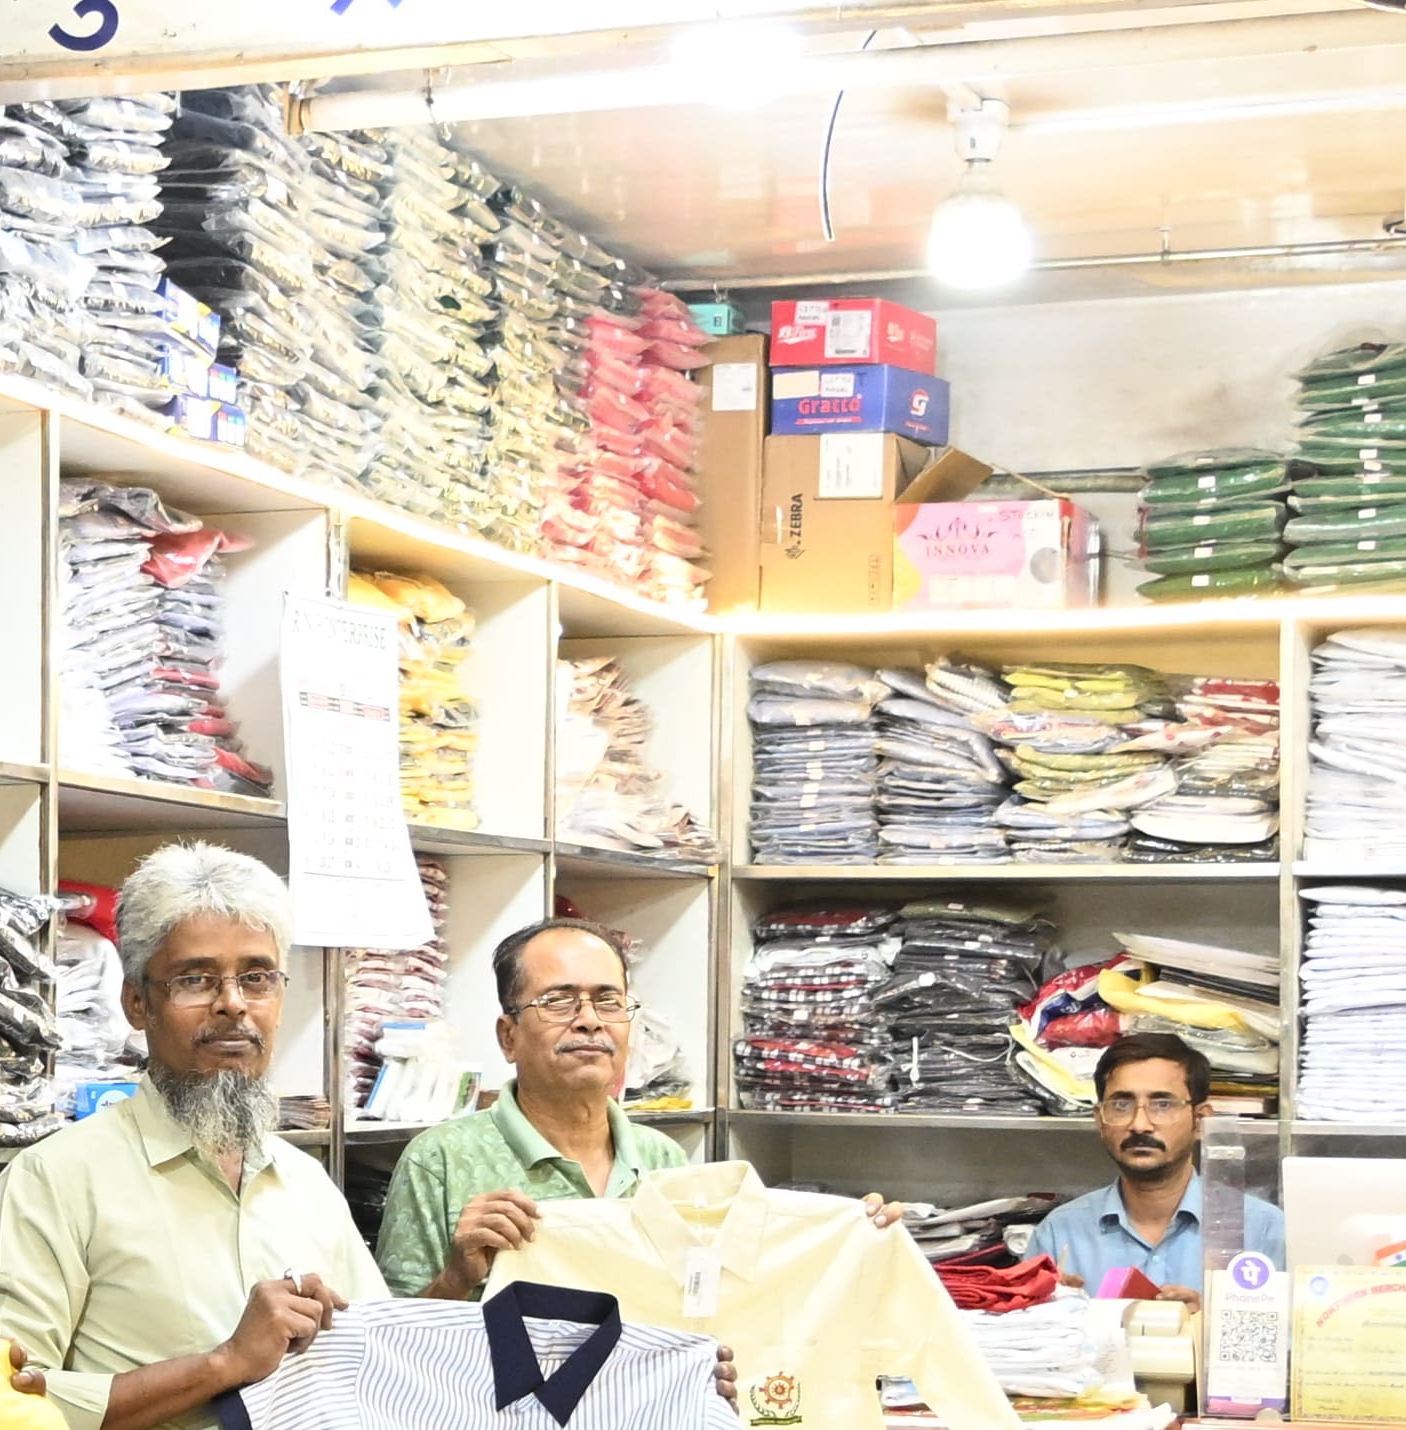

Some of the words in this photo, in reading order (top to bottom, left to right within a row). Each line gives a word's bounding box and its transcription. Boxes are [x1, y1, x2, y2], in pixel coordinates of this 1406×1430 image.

[789, 493, 804, 538] ZEBRA
[926, 543, 990, 557] INNOVA
[1225, 1291, 1275, 1304] PhonePe
